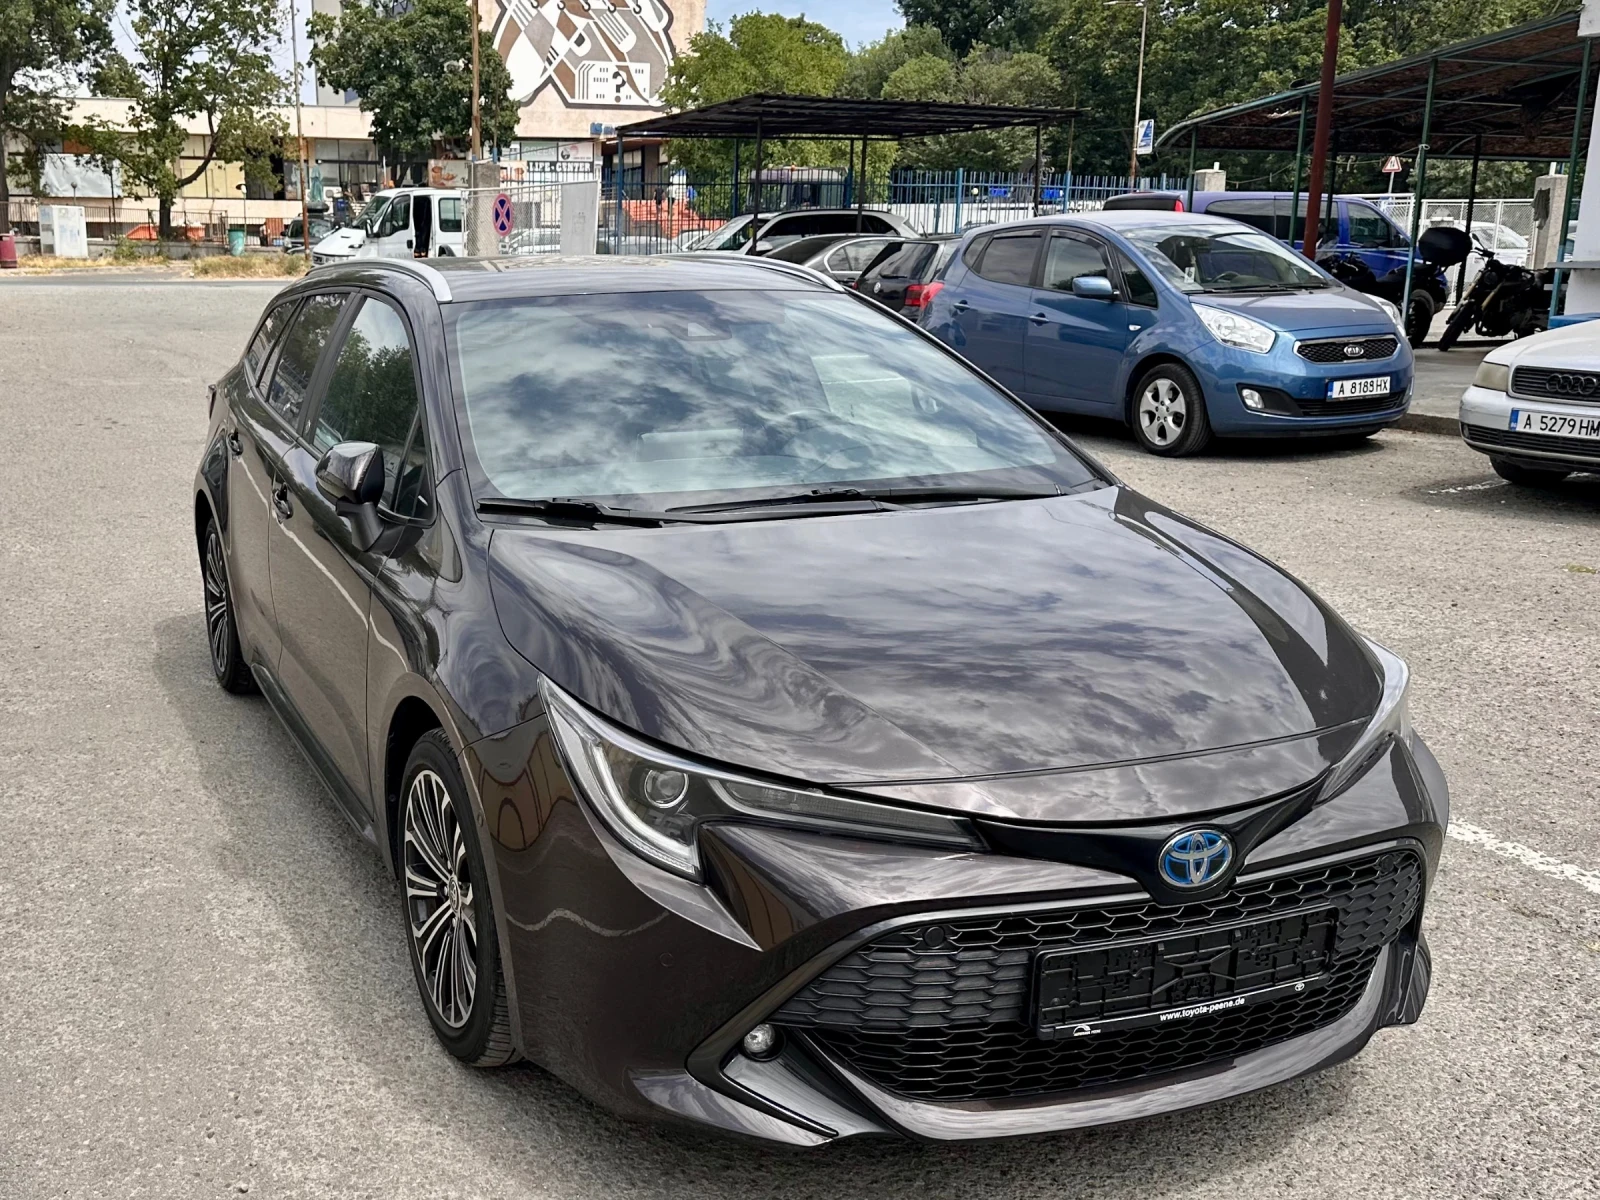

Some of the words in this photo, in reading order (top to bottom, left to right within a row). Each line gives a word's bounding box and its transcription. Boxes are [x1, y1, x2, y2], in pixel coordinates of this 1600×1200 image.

[1338, 381, 1345, 395] A
[1523, 413, 1532, 430] A
[1159, 998, 1246, 1021] www.toyota-peene.de
